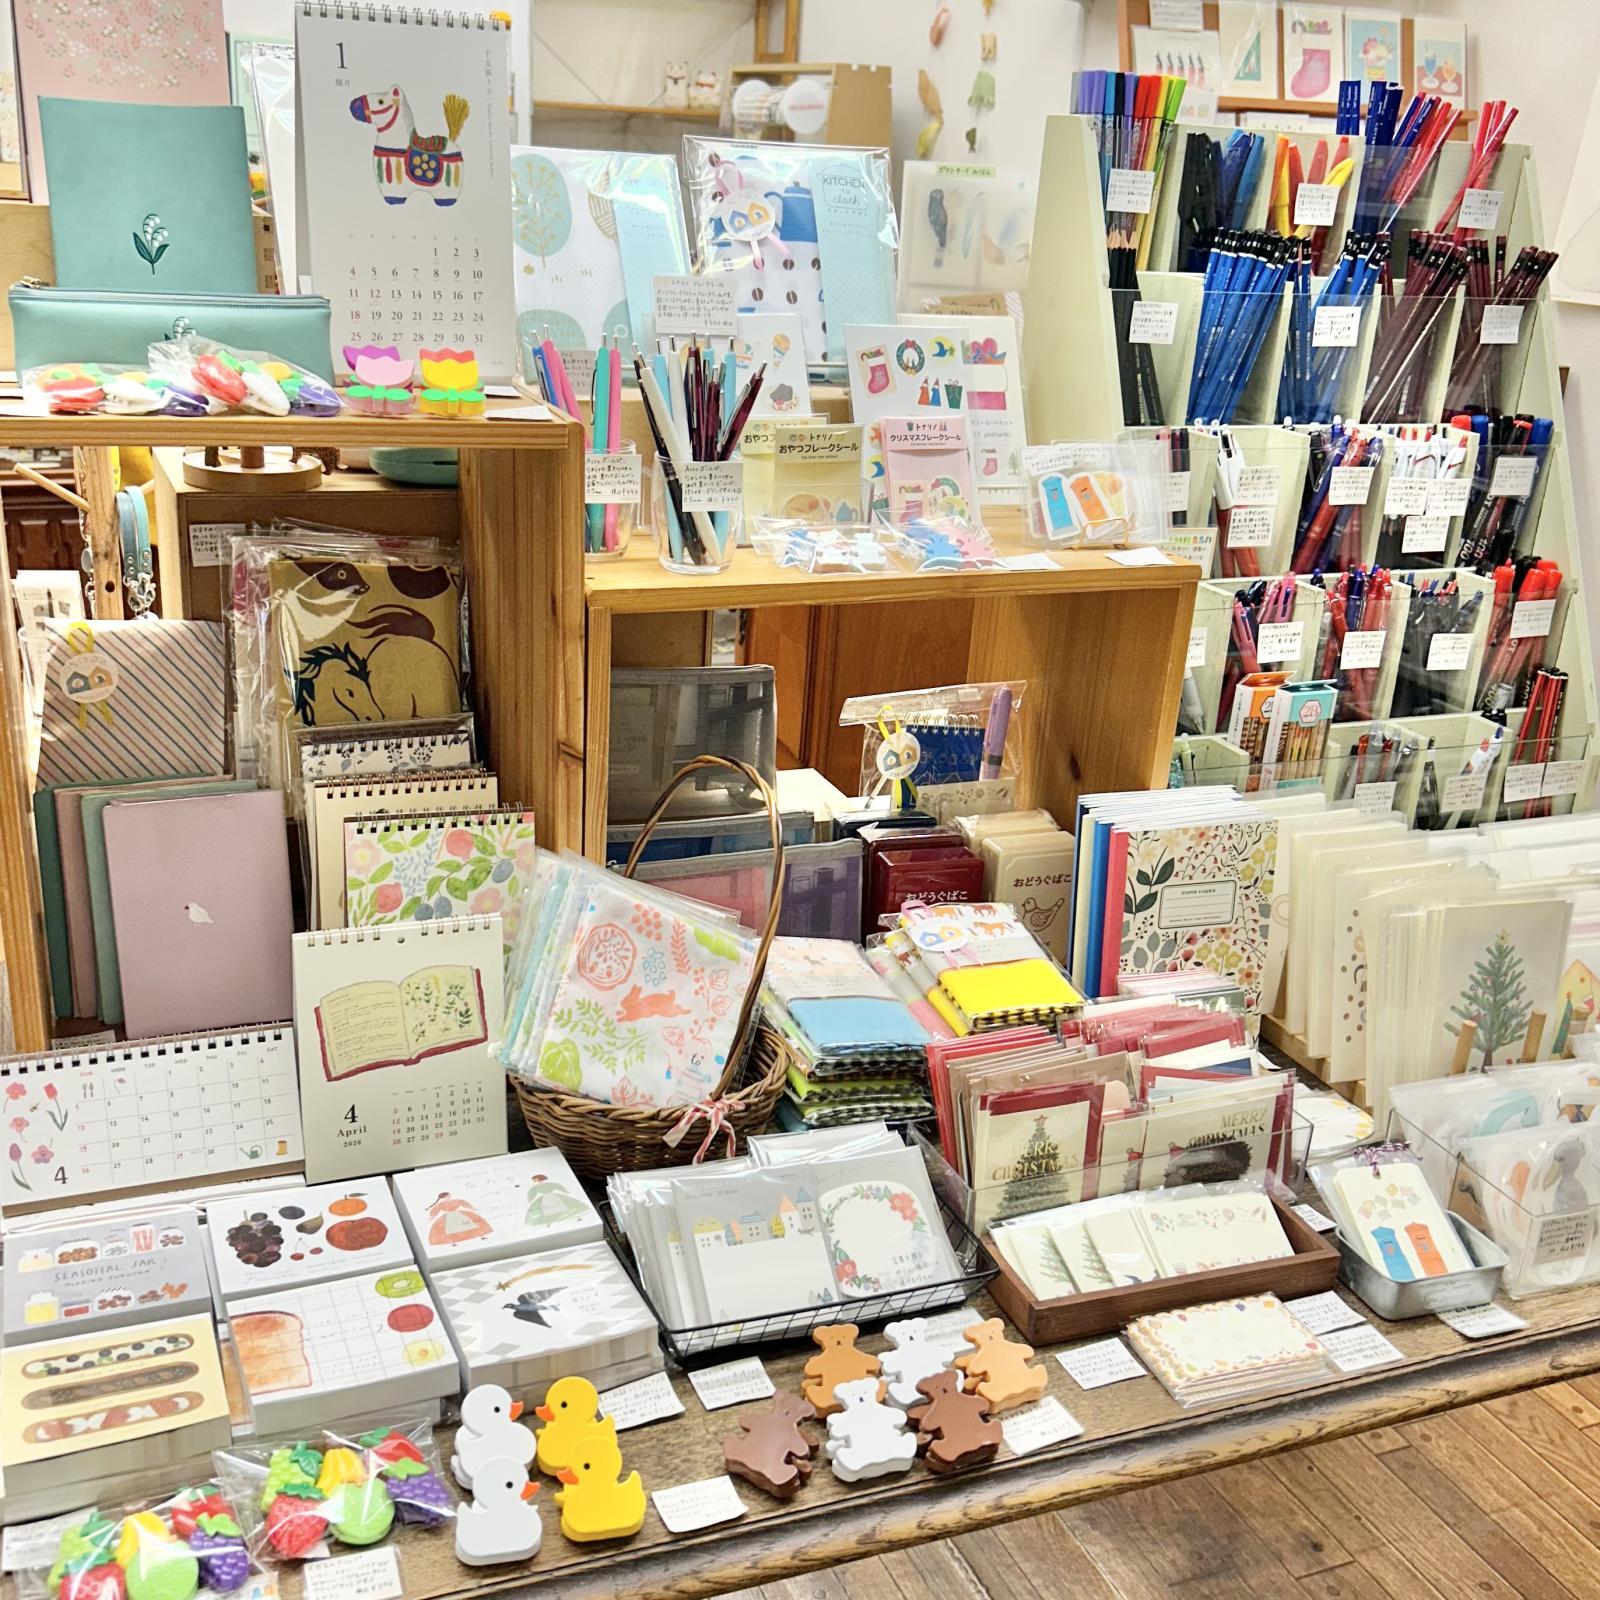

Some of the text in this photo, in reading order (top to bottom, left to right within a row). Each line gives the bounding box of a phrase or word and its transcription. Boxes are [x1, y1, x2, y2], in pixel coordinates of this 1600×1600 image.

[336, 42, 348, 69] 1
[824, 176, 864, 188] KITCHEN
[434, 248, 479, 257] 1 2 3
[350, 266, 356, 276] 4
[372, 268, 376, 276] 5
[392, 268, 398, 277] 6
[434, 269, 439, 278] 8
[454, 270, 459, 279] 9
[473, 270, 482, 279] 10
[350, 289, 483, 300] 11 12 13 14 15 16 17
[351, 310, 484, 322] 18 19 20 21 22 23 24
[351, 332, 483, 343] 25 26 27 28 29 30 31
[916, 422, 936, 430] トナリノ
[810, 433, 832, 441] トナリノ
[890, 433, 961, 442] クリスマスフレークシール
[778, 444, 858, 454] おやつフレークシール
[1014, 874, 1072, 888] おどうぐばこ
[906, 890, 968, 902] おどうぐばこ
[344, 1104, 358, 1124] 4
[337, 1126, 367, 1138] April
[54, 1166, 68, 1184] 4
[54, 1263, 122, 1282] SEASONAL
